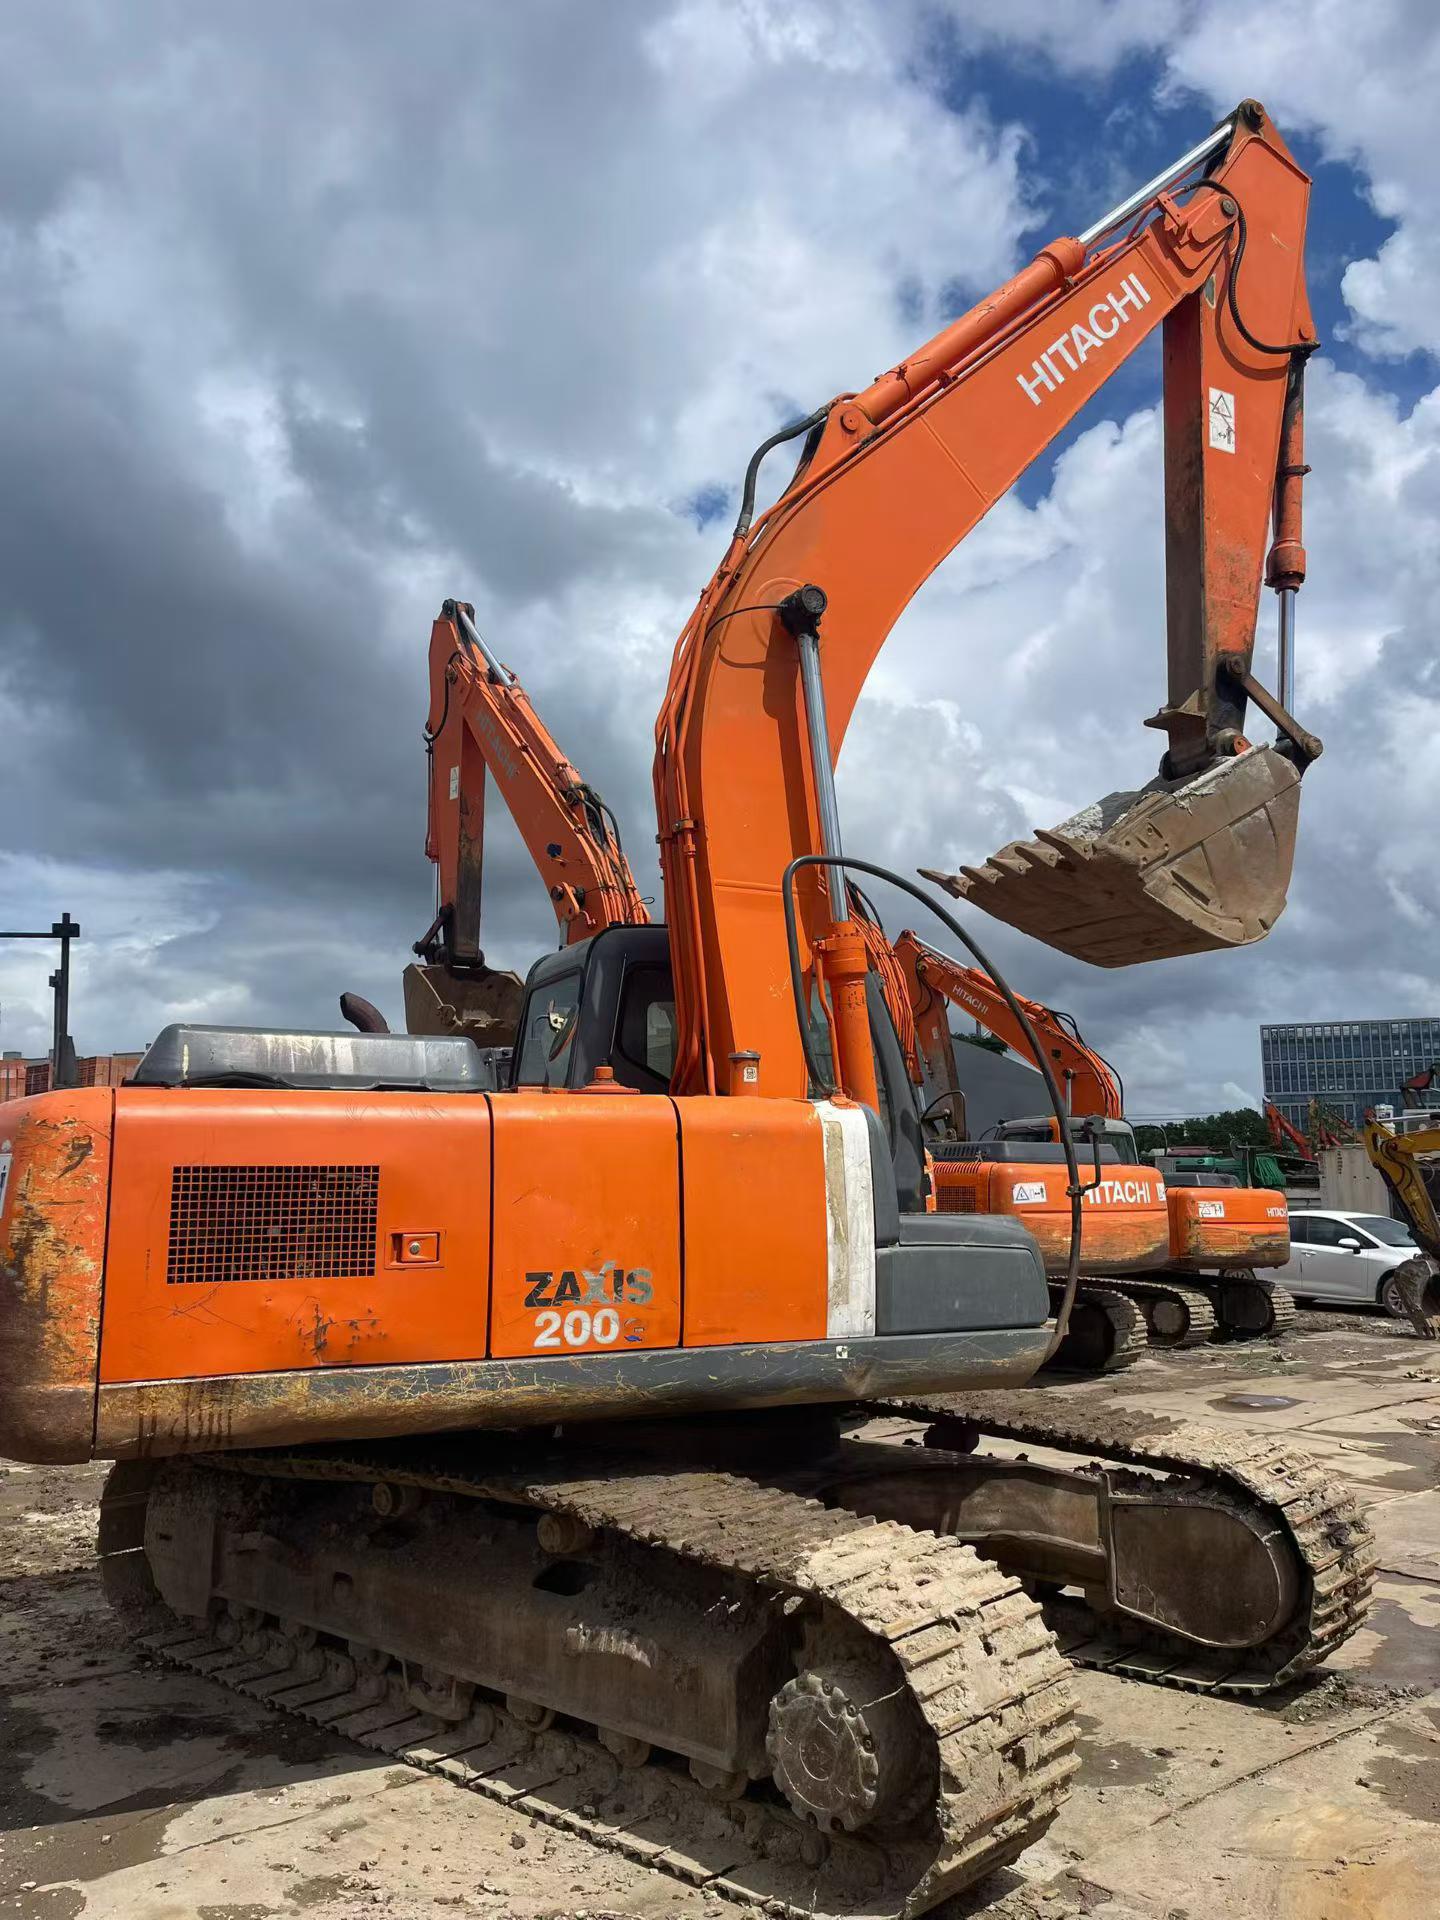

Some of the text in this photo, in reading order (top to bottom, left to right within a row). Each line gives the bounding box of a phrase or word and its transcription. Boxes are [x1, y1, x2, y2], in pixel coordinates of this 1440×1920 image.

[1016, 273, 1151, 406] HITACHI
[952, 984, 989, 1015] HITACHI
[524, 1261, 654, 1308] ZAXIS
[533, 1308, 620, 1348] 200
